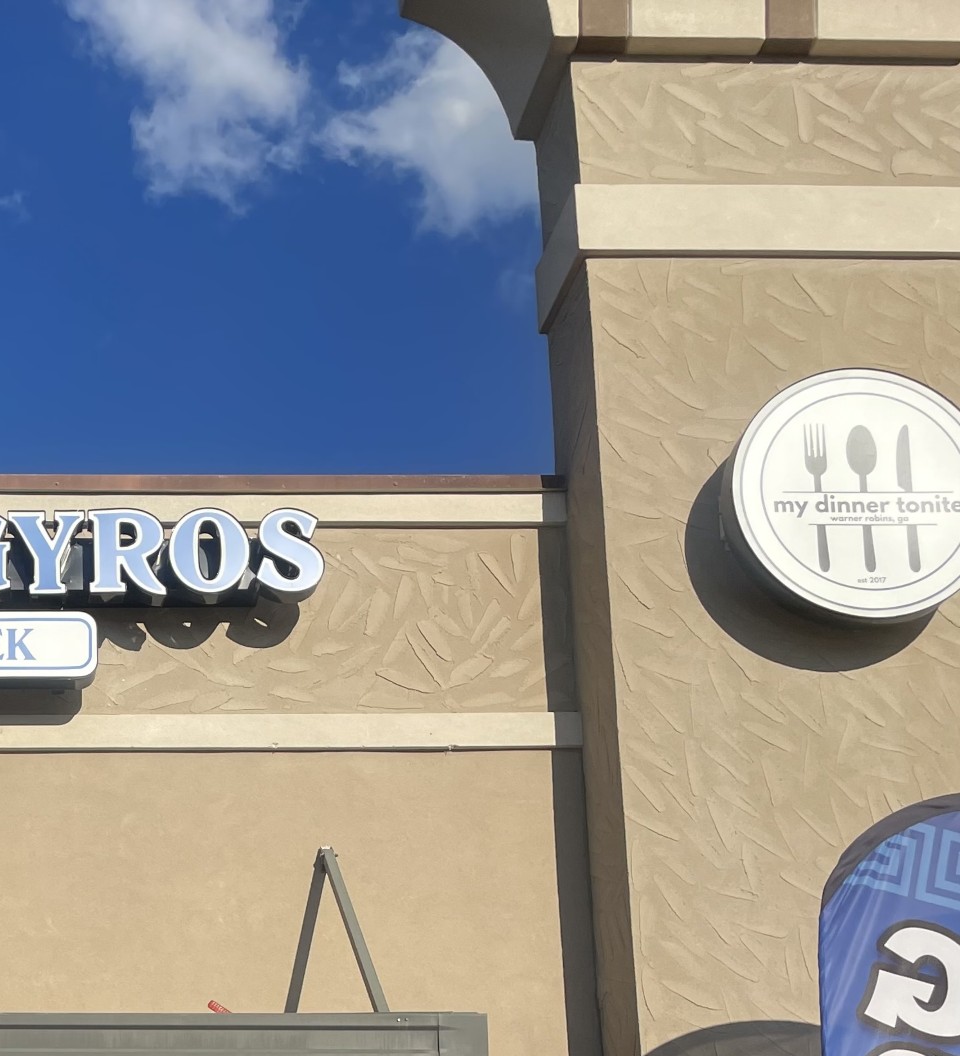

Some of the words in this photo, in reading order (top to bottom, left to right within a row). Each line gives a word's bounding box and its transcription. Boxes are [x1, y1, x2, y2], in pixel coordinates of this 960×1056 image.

[773, 500, 808, 518] my
[815, 493, 890, 513] dinner
[896, 494, 960, 513] tonite
[869, 576, 887, 584] 2017
